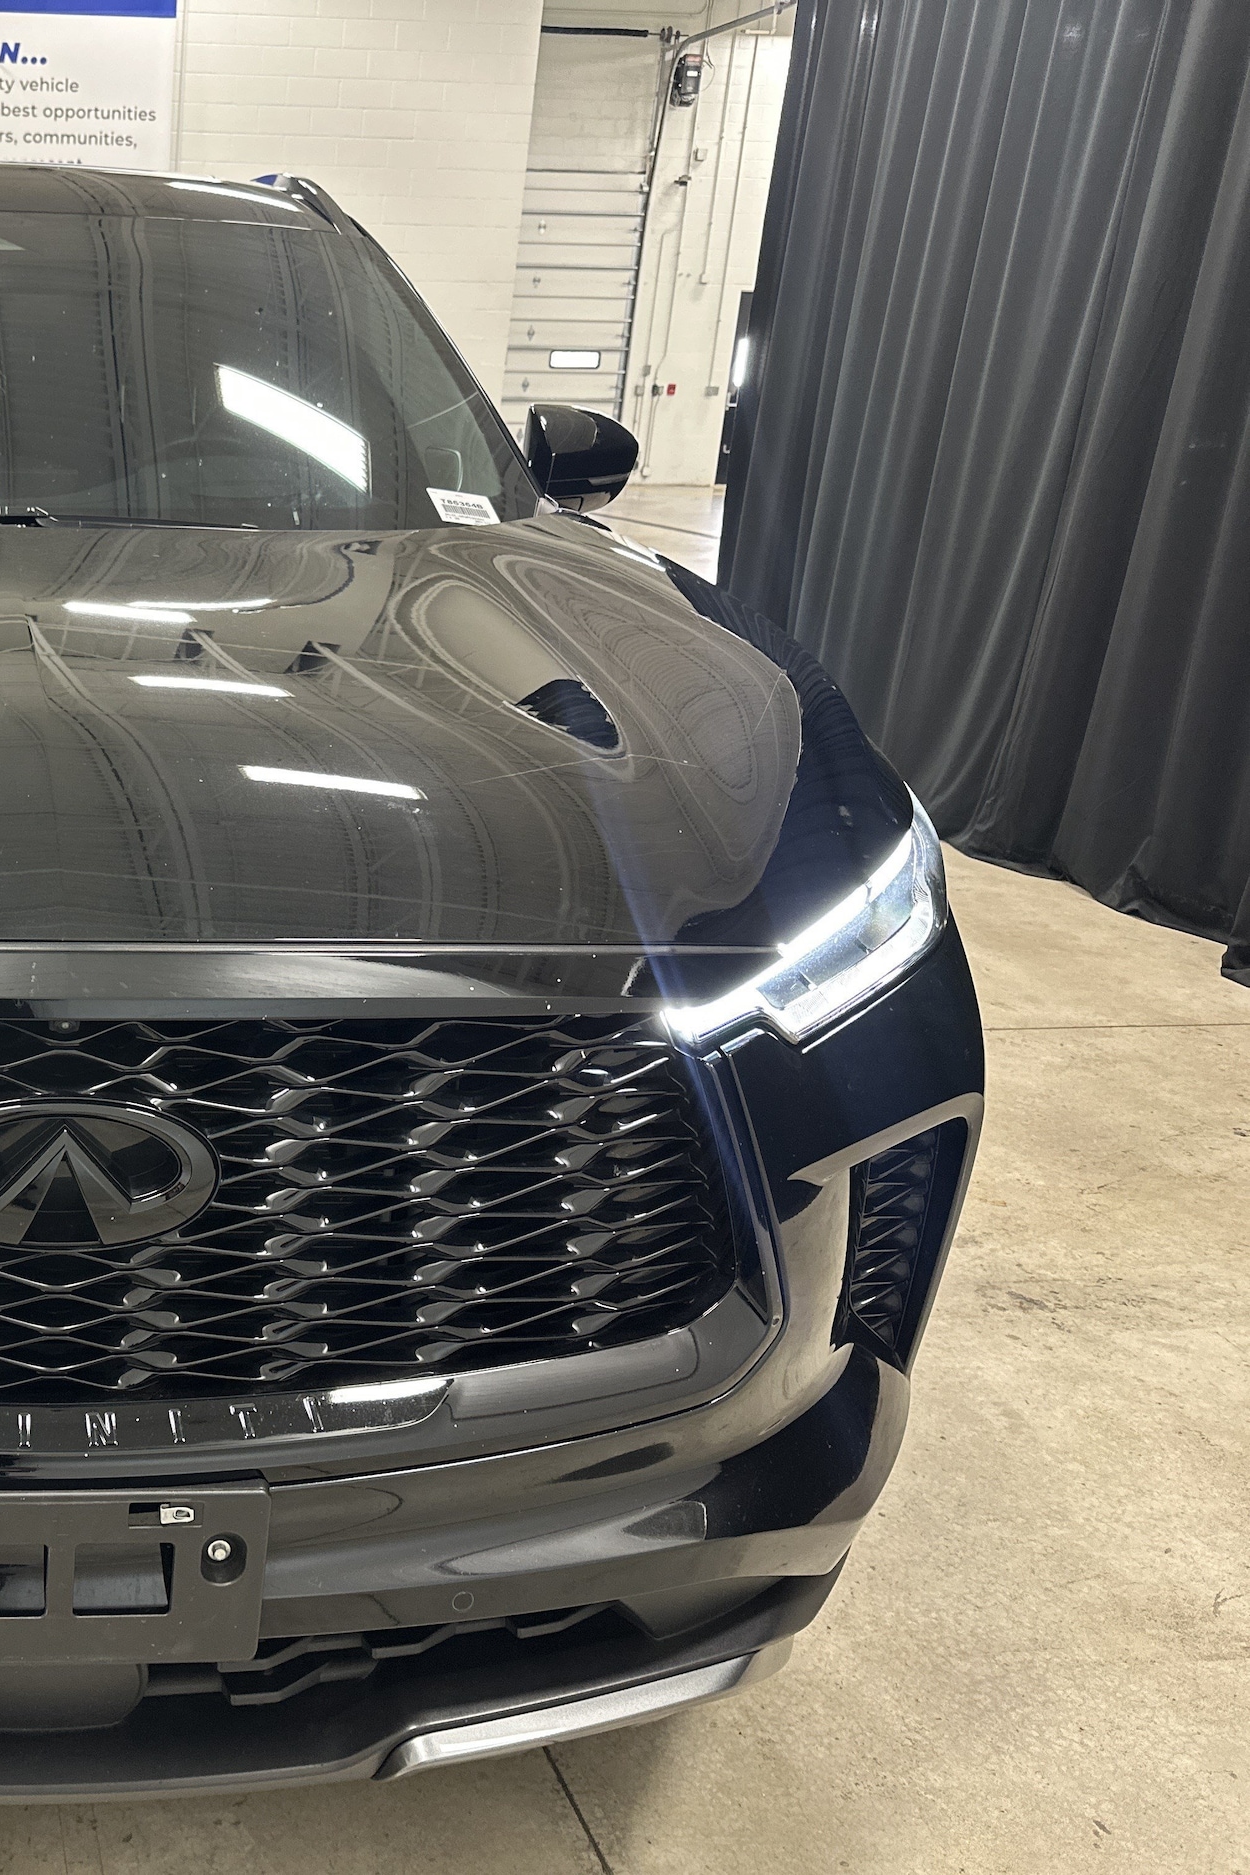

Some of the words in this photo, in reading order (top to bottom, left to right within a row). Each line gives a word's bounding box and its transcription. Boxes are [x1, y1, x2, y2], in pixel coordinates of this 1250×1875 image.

[19, 77, 80, 93] vehicle
[0, 102, 38, 118] best
[42, 105, 157, 122] opportunities
[22, 130, 138, 149] communities,
